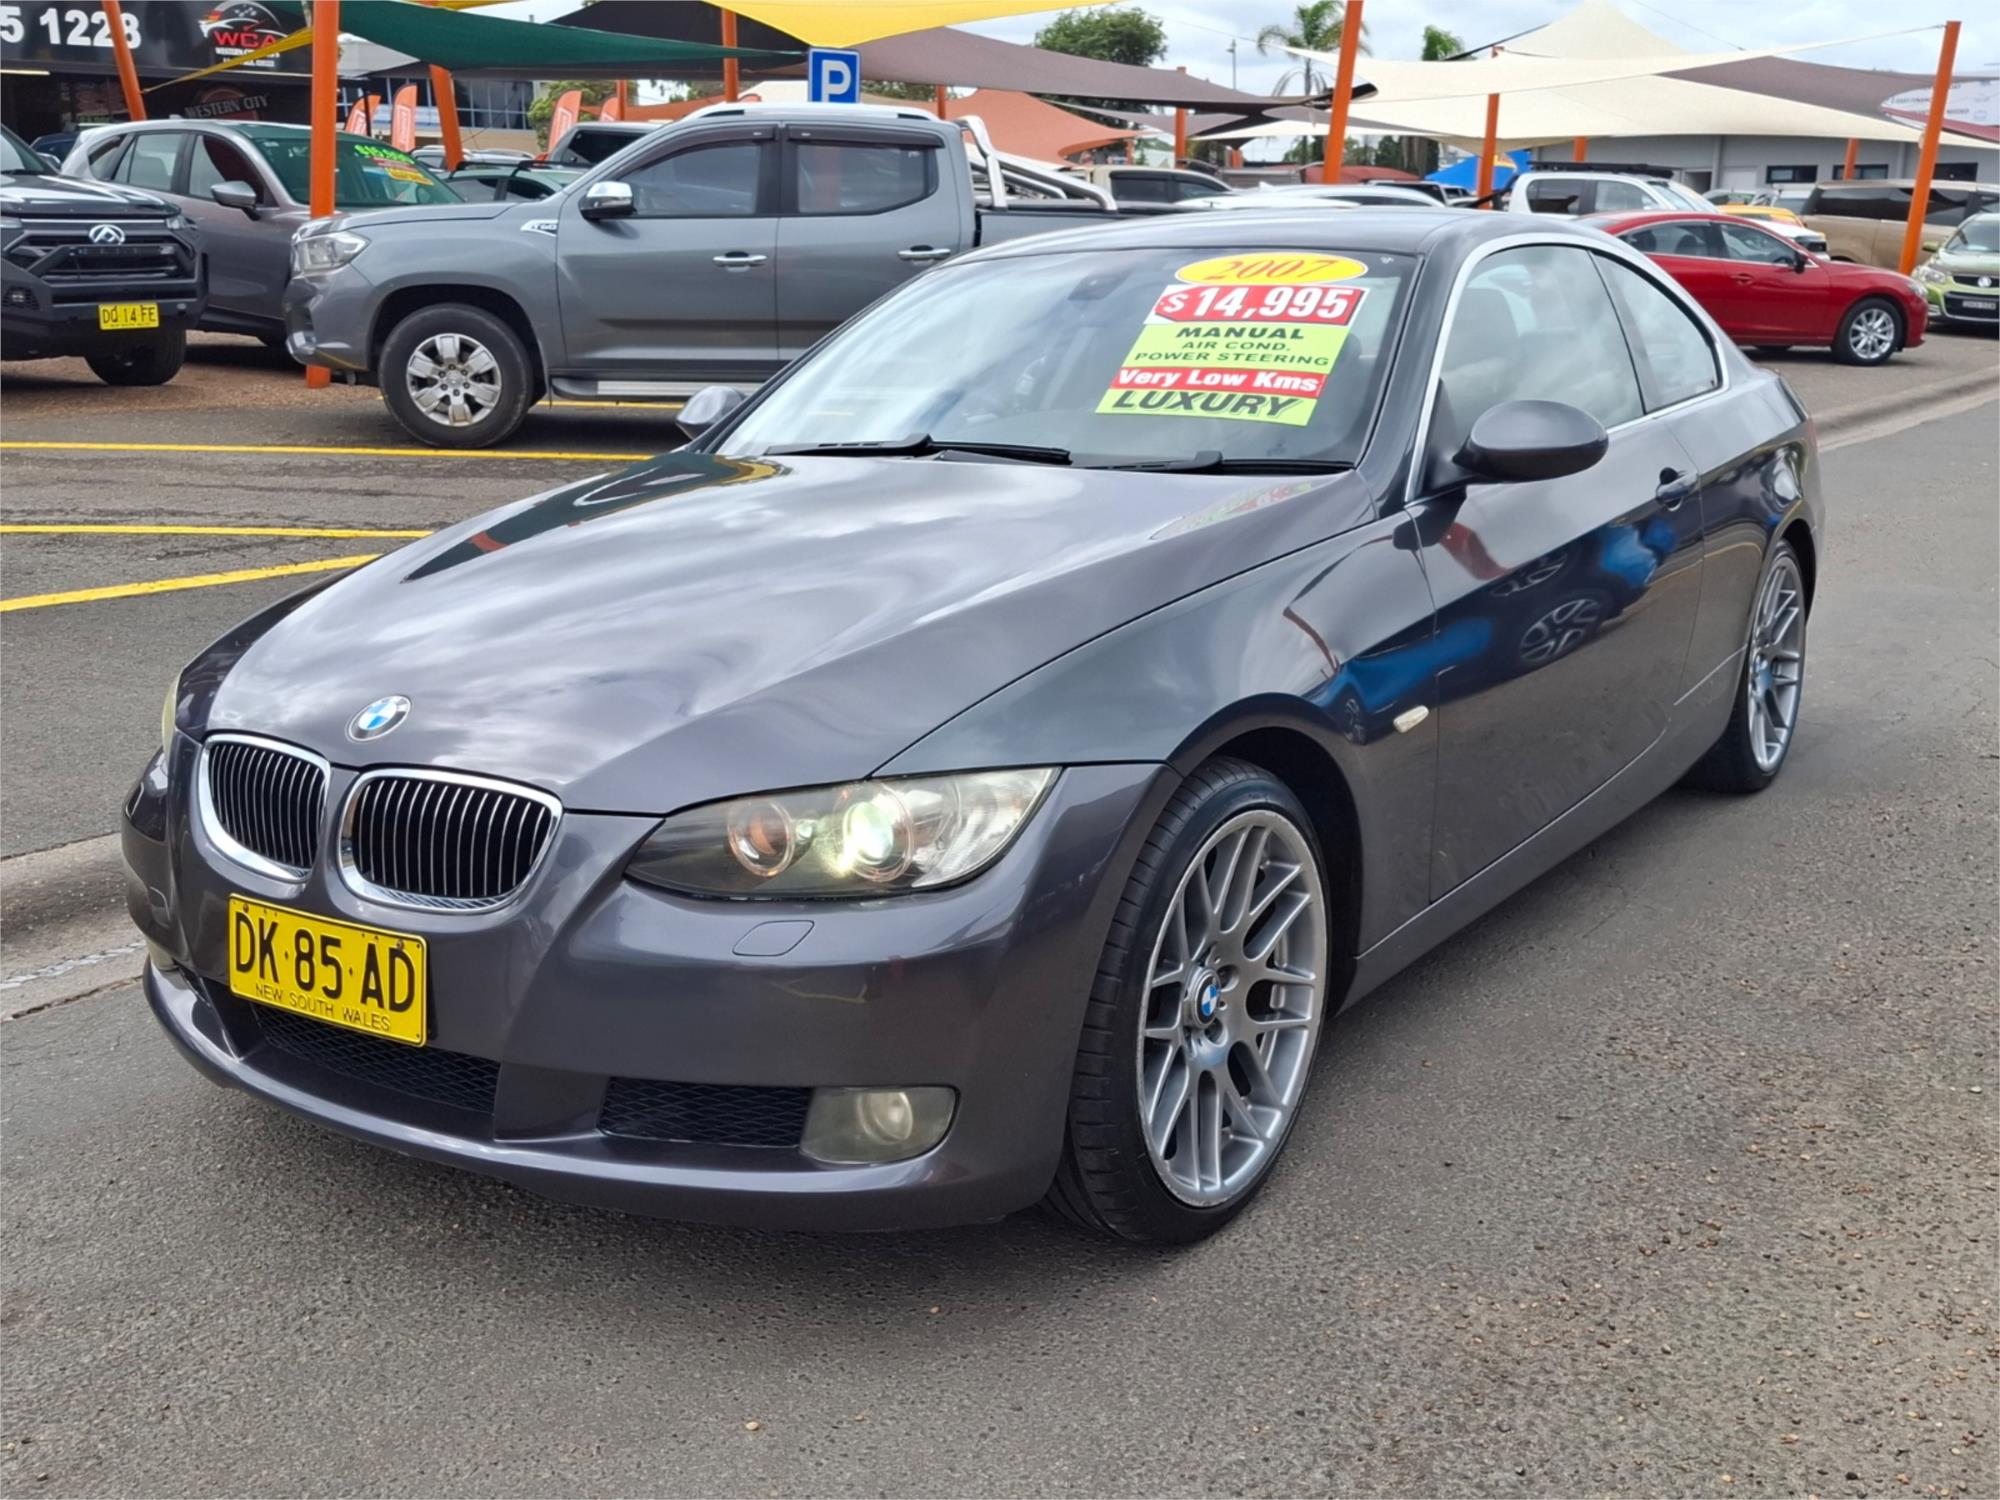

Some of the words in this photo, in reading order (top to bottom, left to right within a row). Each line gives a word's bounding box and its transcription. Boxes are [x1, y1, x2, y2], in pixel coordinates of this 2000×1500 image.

[0, 6, 24, 43] 5
[213, 31, 278, 49] WCA
[822, 60, 851, 103] P
[184, 100, 240, 118] WESTERN
[243, 95, 268, 110] CITY
[1202, 259, 1340, 281] 2007
[1175, 327, 1304, 340] MANUAL
[1182, 341, 1217, 350] AIR
[1225, 341, 1291, 352] COND.
[1134, 352, 1210, 361] POWER
[1217, 353, 1329, 367] STEERING
[1118, 368, 1183, 388] Very
[1186, 369, 1248, 387] Low
[1252, 372, 1320, 392] Kms
[1111, 389, 1304, 419] LUXURY
[255, 983, 283, 1002] NEW
[289, 992, 335, 1018] SOUTH
[343, 1007, 391, 1032] WALES
